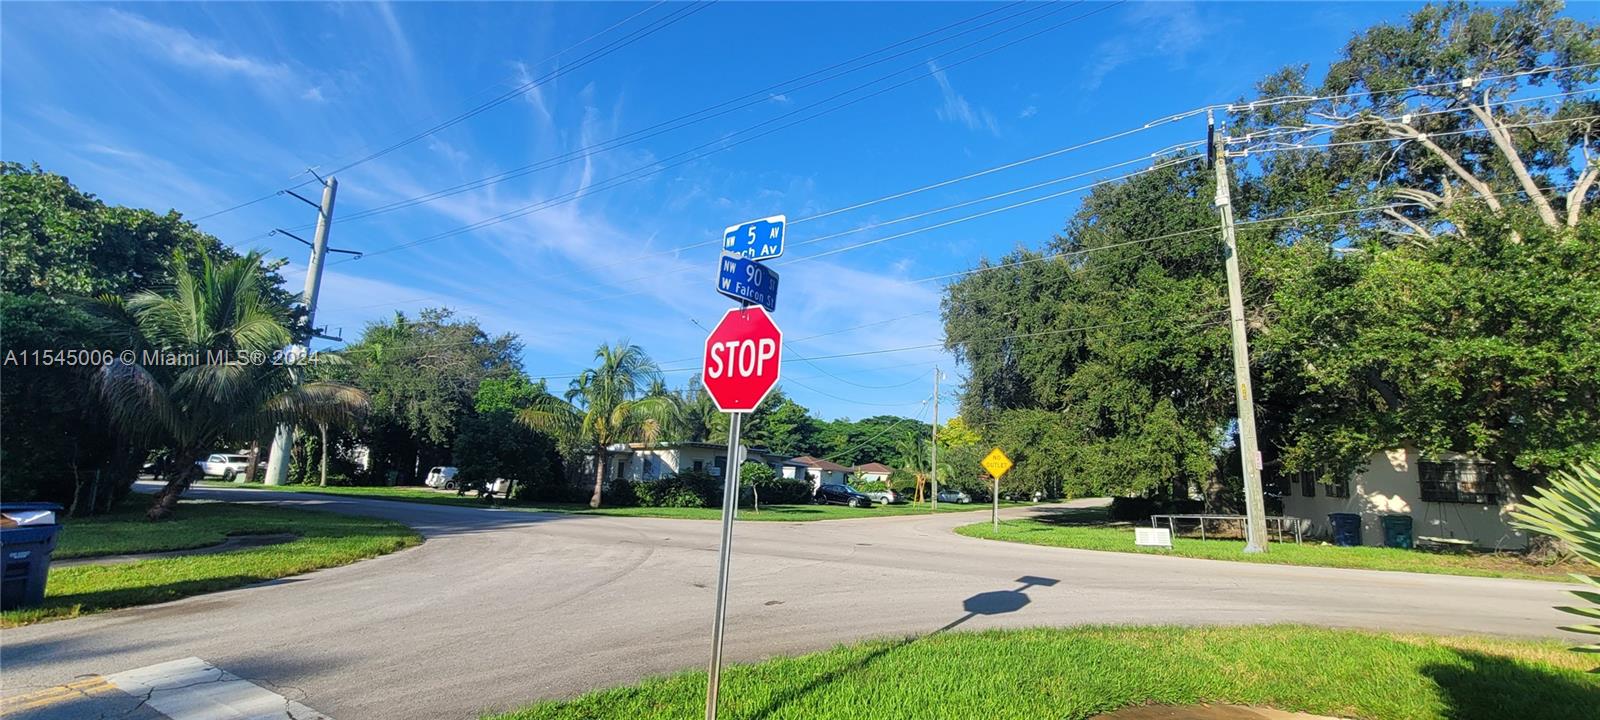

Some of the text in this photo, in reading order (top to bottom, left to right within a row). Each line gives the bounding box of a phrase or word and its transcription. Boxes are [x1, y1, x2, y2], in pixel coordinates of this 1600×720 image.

[726, 226, 780, 247] NW 5 AV
[760, 244, 777, 256] Av
[723, 260, 736, 274] NW
[746, 264, 762, 287] 90
[722, 277, 774, 308] W Falcon St
[708, 338, 775, 379] STOP
